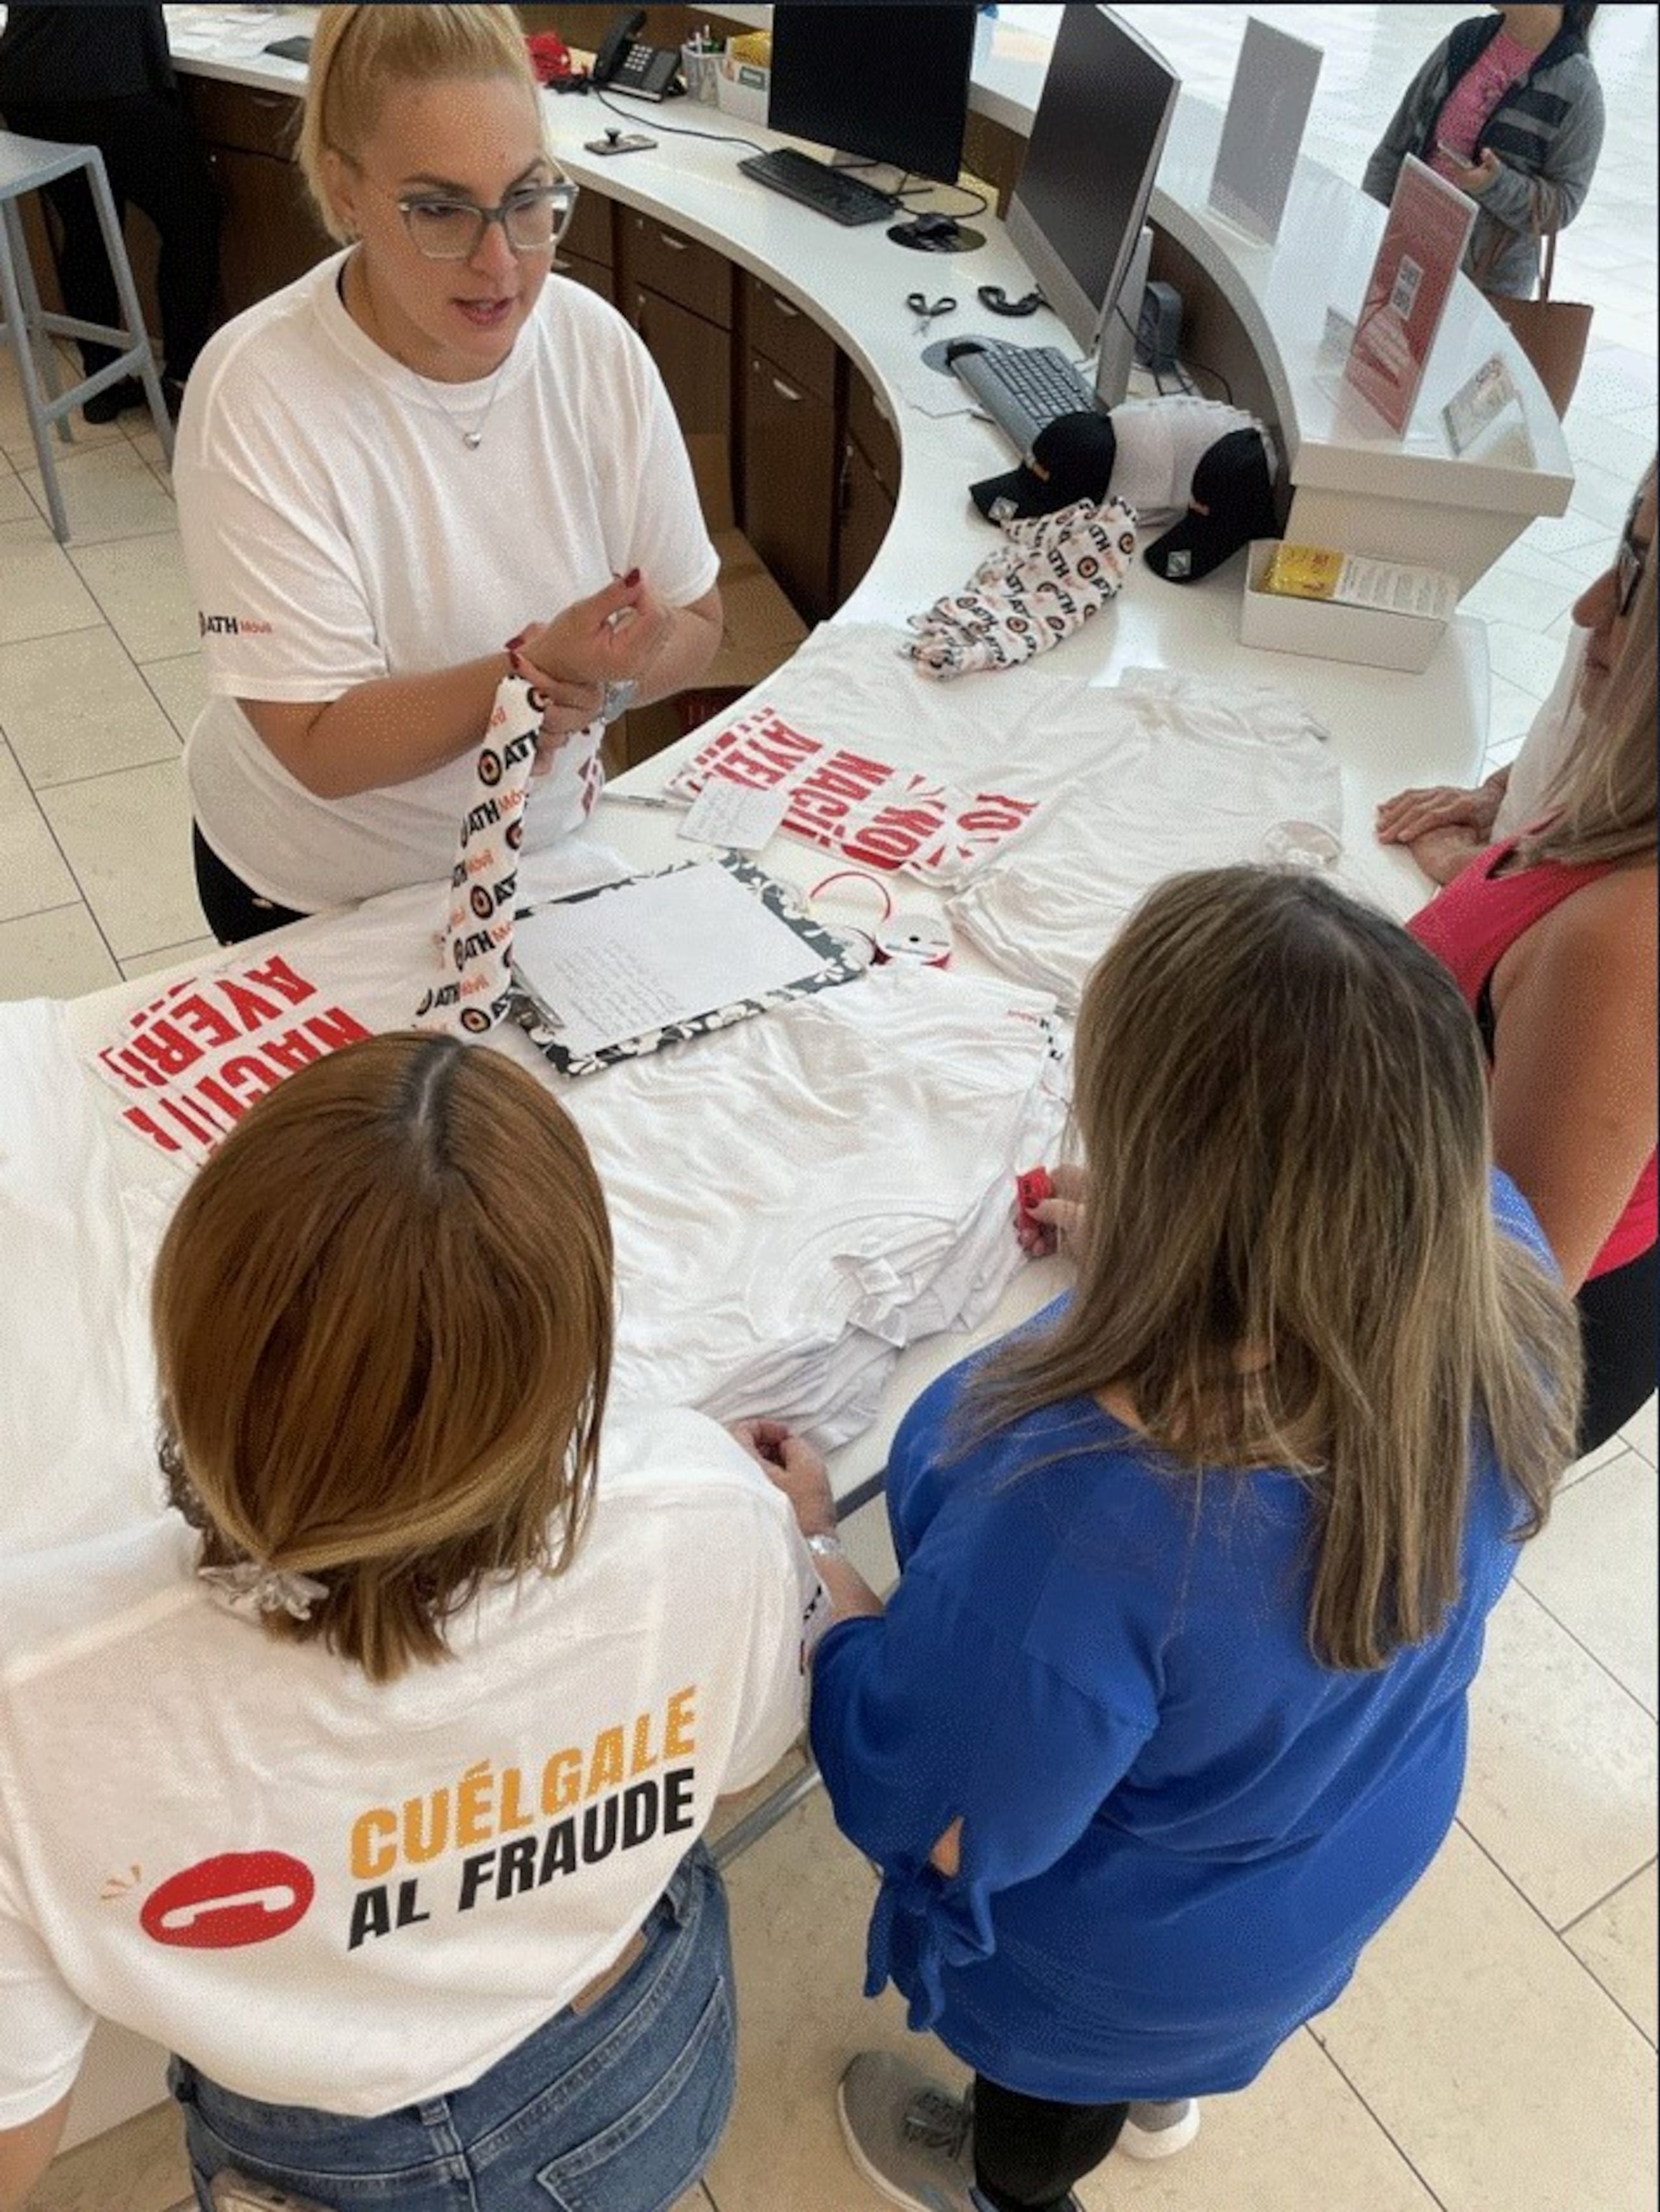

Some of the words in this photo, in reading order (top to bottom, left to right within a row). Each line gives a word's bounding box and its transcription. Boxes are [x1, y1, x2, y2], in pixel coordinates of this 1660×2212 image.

[207, 616, 239, 635] ATH
[712, 718, 823, 792] AYE
[468, 798, 501, 836] ATH
[465, 930, 495, 961] ATH
[350, 1684, 697, 1881] CUÉLGALE
[348, 1885, 431, 1952] AL
[458, 1767, 696, 1913] FRAUDE
